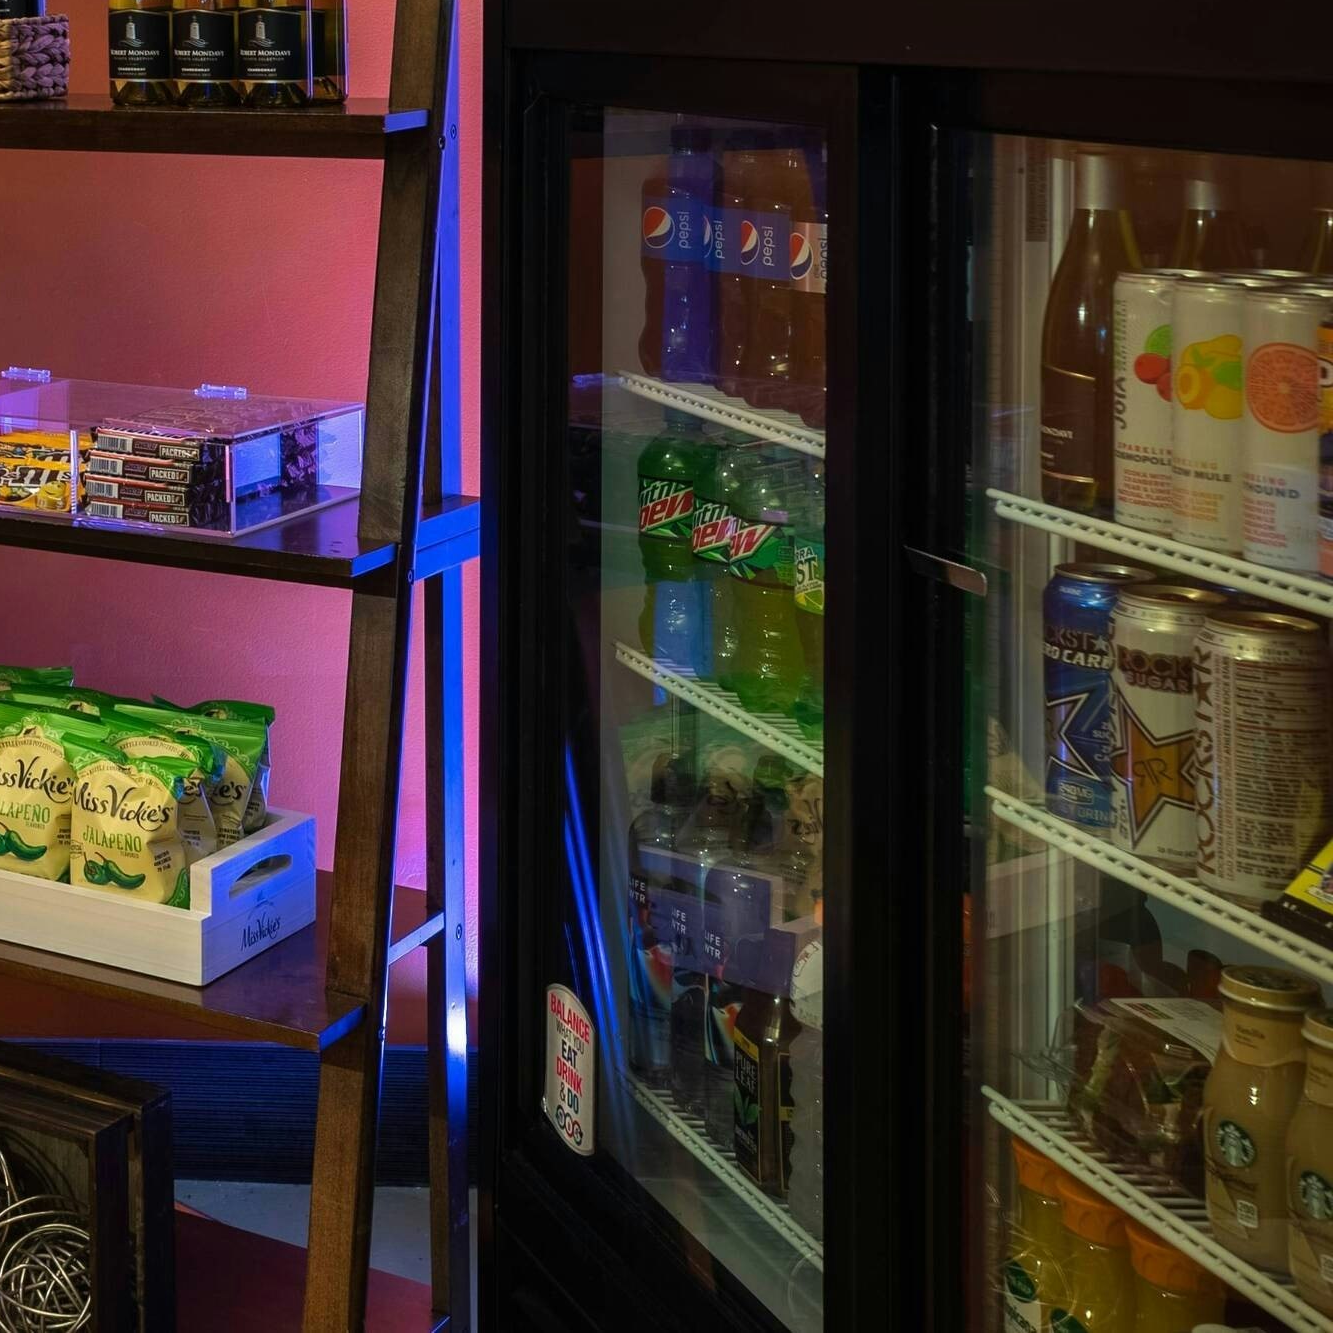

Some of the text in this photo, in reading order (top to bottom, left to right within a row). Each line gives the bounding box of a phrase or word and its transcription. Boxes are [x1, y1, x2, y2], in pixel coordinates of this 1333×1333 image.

[677, 211, 692, 250] pepsi
[713, 220, 726, 259] pepsi
[761, 226, 776, 267] pepsi
[1114, 377, 1127, 430] JOIA
[1117, 442, 1172, 455] SPARKLIN
[151, 469, 175, 480] PACKED
[1194, 470, 1232, 483] MULE
[147, 492, 173, 503] PACKED
[151, 514, 175, 524] PACKED
[797, 560, 817, 584] ST
[1118, 645, 1193, 679] ROCK
[1126, 671, 1190, 693] SUGAR
[73, 782, 110, 814] Miss
[108, 784, 174, 832] Vickie's
[82, 824, 142, 853] JALAPEÑO
[240, 912, 281, 951] Miss Vickie's
[704, 929, 721, 946] LIFE
[704, 943, 721, 960] WTR
[550, 993, 590, 1045] BALANCE
[556, 1019, 585, 1055] WHAT YOU
[561, 1038, 577, 1068] EAT
[556, 1056, 583, 1098] DRINK
[559, 1084, 579, 1115] & DO
